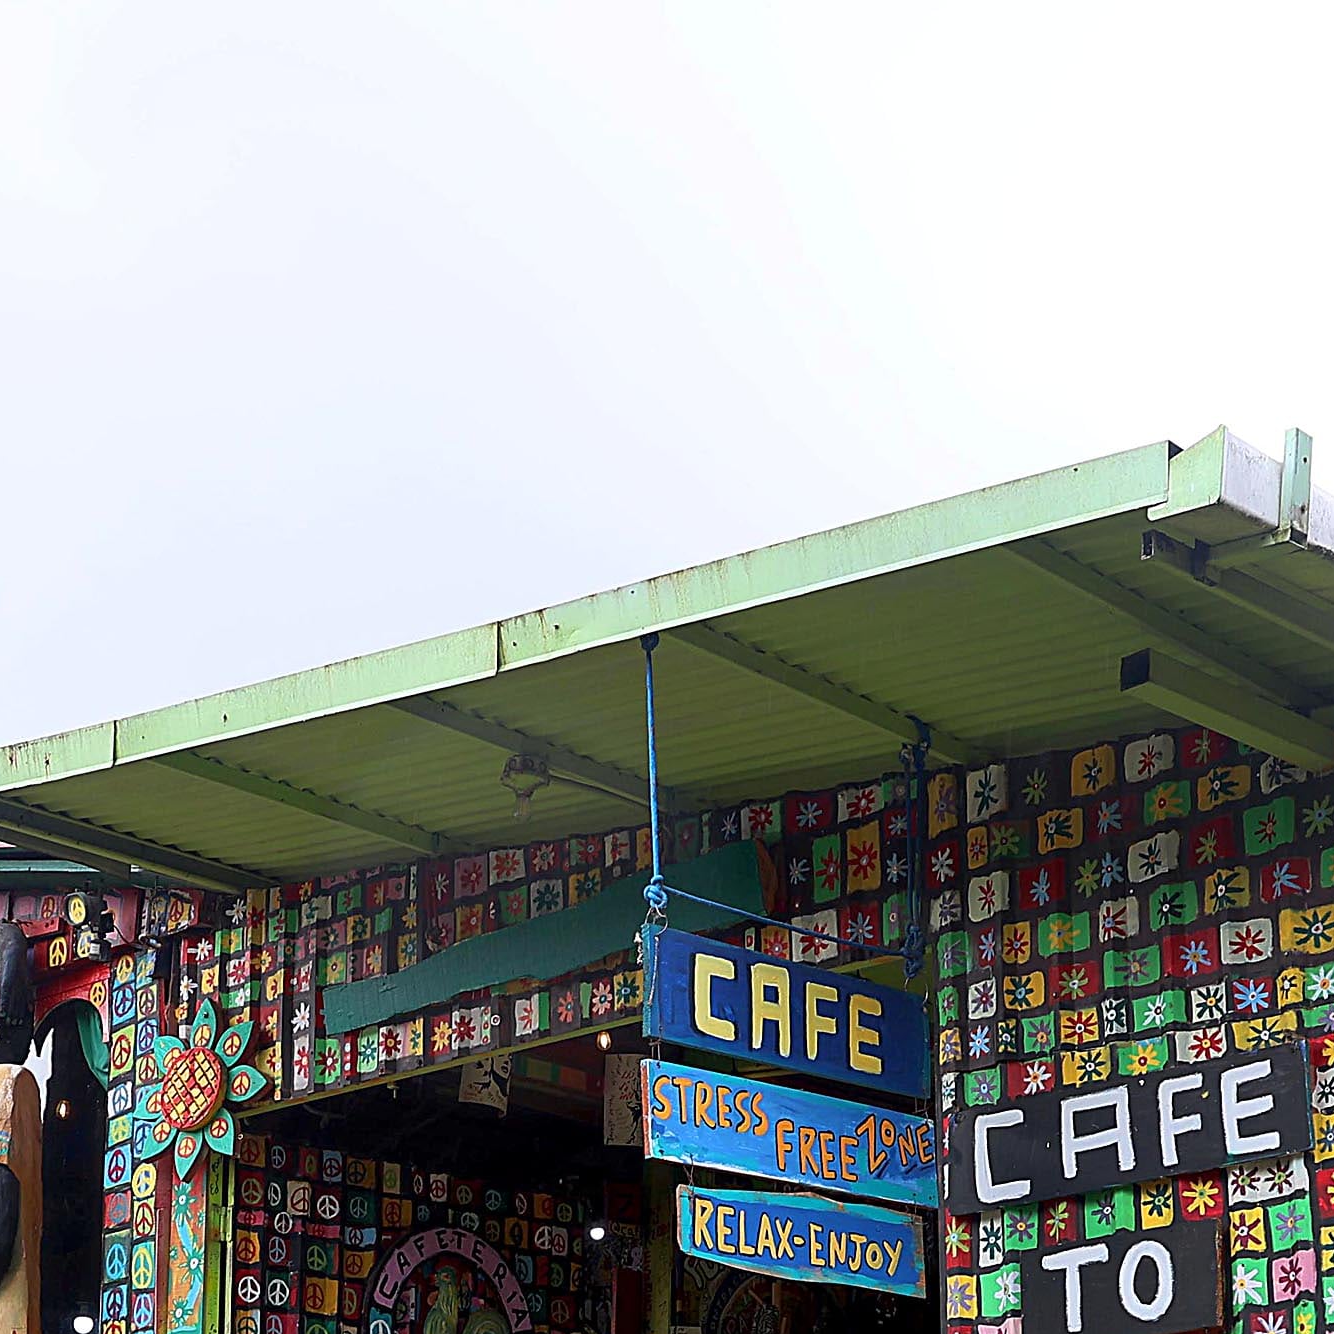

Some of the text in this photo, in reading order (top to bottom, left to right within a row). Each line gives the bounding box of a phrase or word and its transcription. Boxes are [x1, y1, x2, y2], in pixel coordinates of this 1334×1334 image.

[694, 952, 883, 1075] CAFE
[652, 1076, 769, 1136] STRESS
[776, 1120, 860, 1182] FREE
[857, 1114, 935, 1173] ZONE
[973, 1060, 1280, 1203] CAFE
[378, 1229, 529, 1328] CAFETERIA
[693, 1198, 903, 1277] RELAX-ENJOY
[1041, 1240, 1174, 1333] TO
